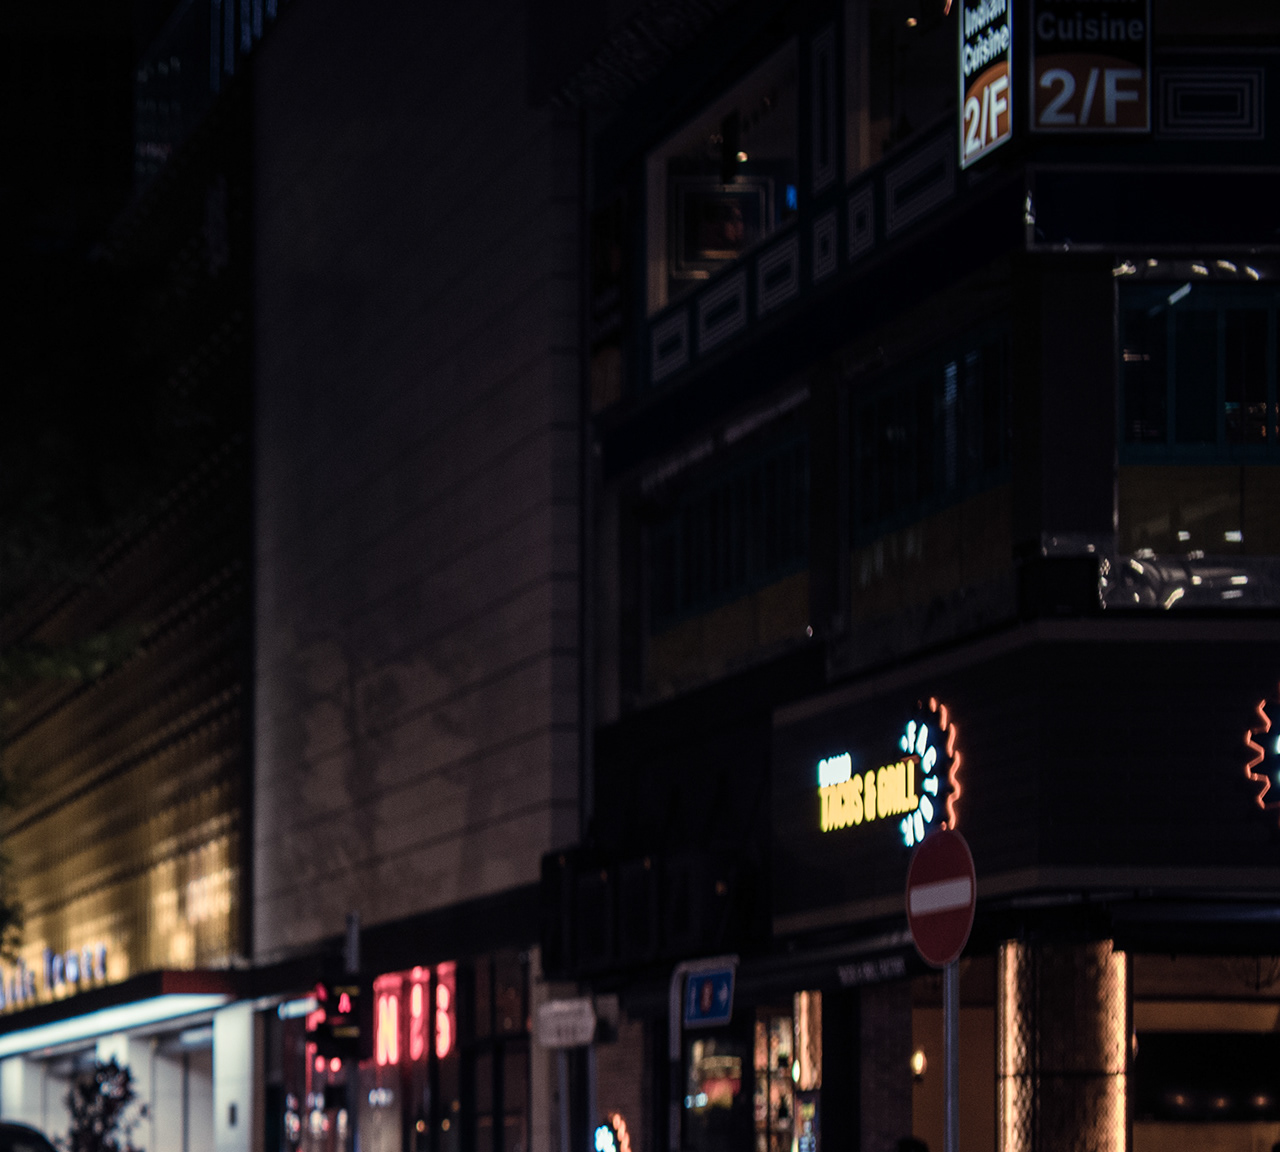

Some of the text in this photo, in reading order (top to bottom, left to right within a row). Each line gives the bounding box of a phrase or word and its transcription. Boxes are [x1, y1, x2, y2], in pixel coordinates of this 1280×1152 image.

[964, 23, 1009, 77] Cuisine
[1037, 10, 1145, 42] Cuisine
[964, 74, 1009, 156] 2/F
[1038, 67, 1143, 125] 2/F
